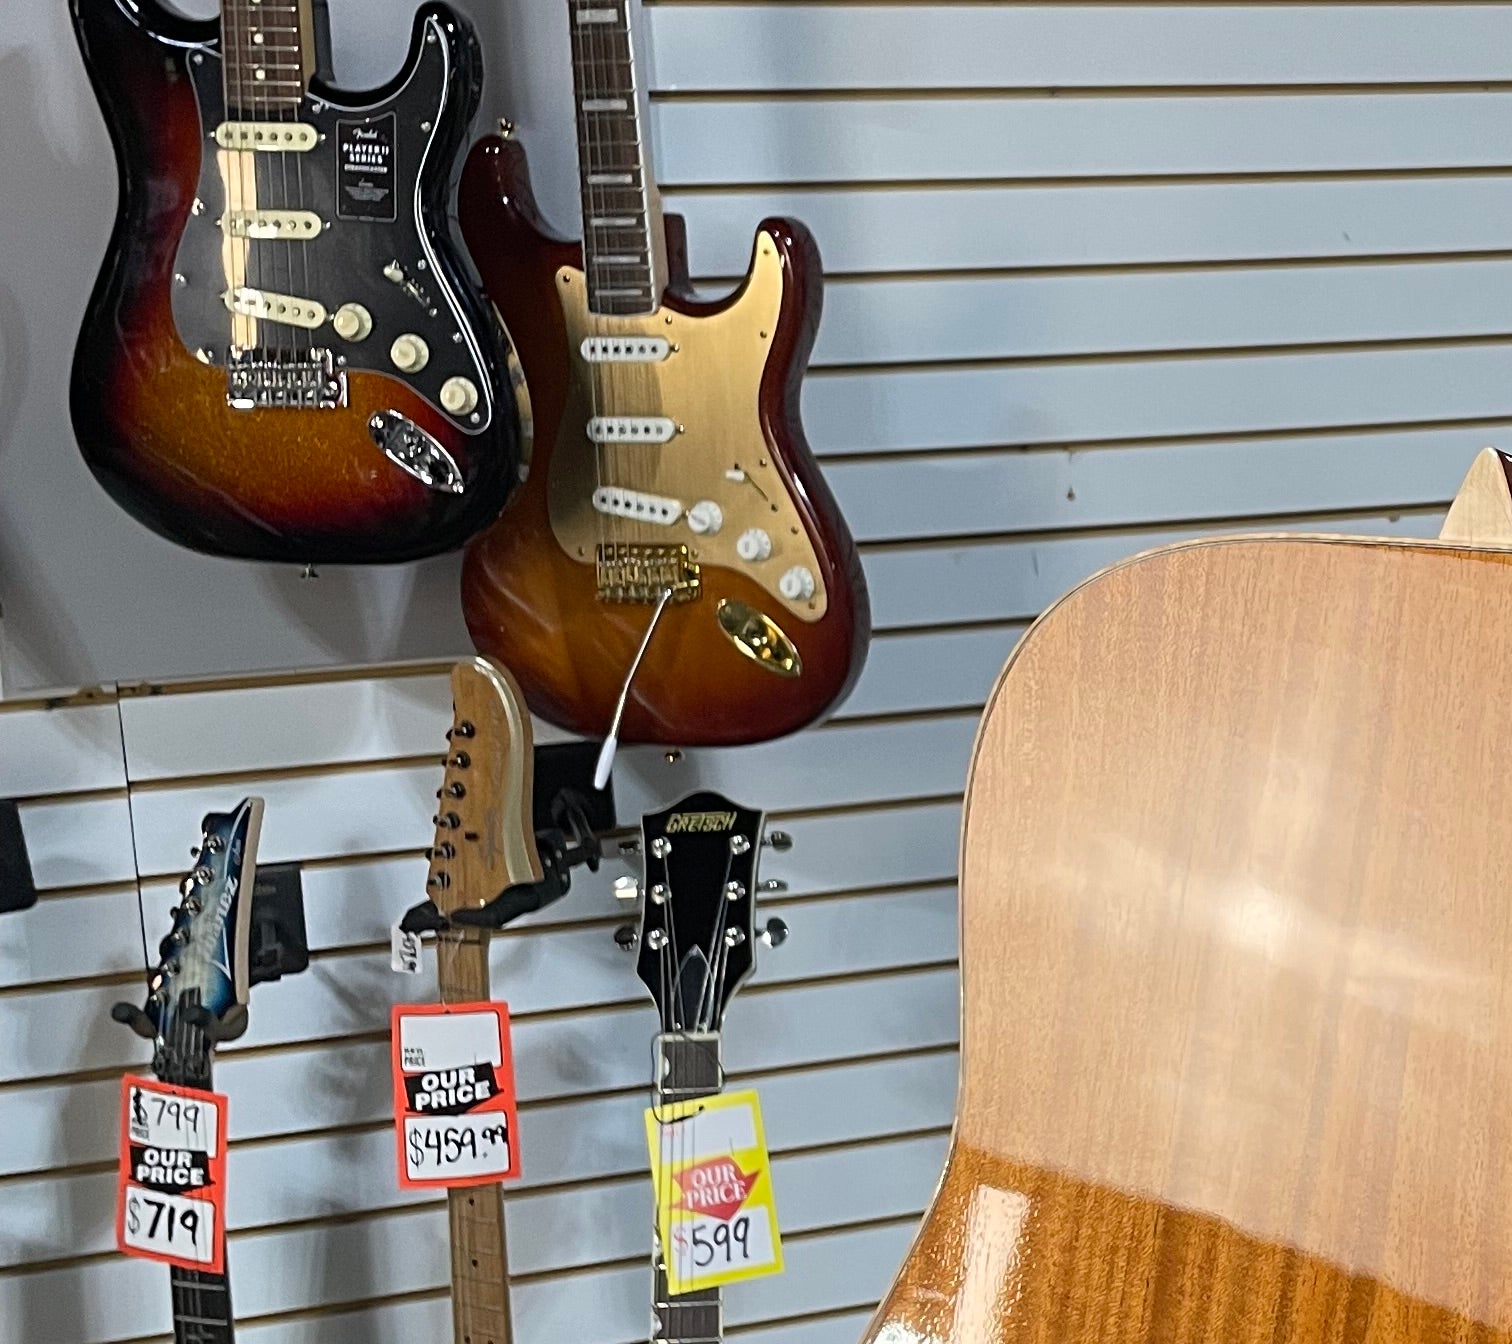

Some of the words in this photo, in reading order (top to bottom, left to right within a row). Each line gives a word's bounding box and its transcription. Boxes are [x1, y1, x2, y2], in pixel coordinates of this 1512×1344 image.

[665, 811, 738, 834] GRETSCH
[421, 1066, 476, 1093] OUR
[414, 1079, 491, 1111] PRICE
[143, 1148, 194, 1168] OUR
[135, 1164, 205, 1186] PRICE
[691, 1163, 738, 1189] OUR
[684, 1180, 748, 1209] PRICE
[127, 1196, 200, 1247] $719
[673, 1216, 751, 1267] $599
